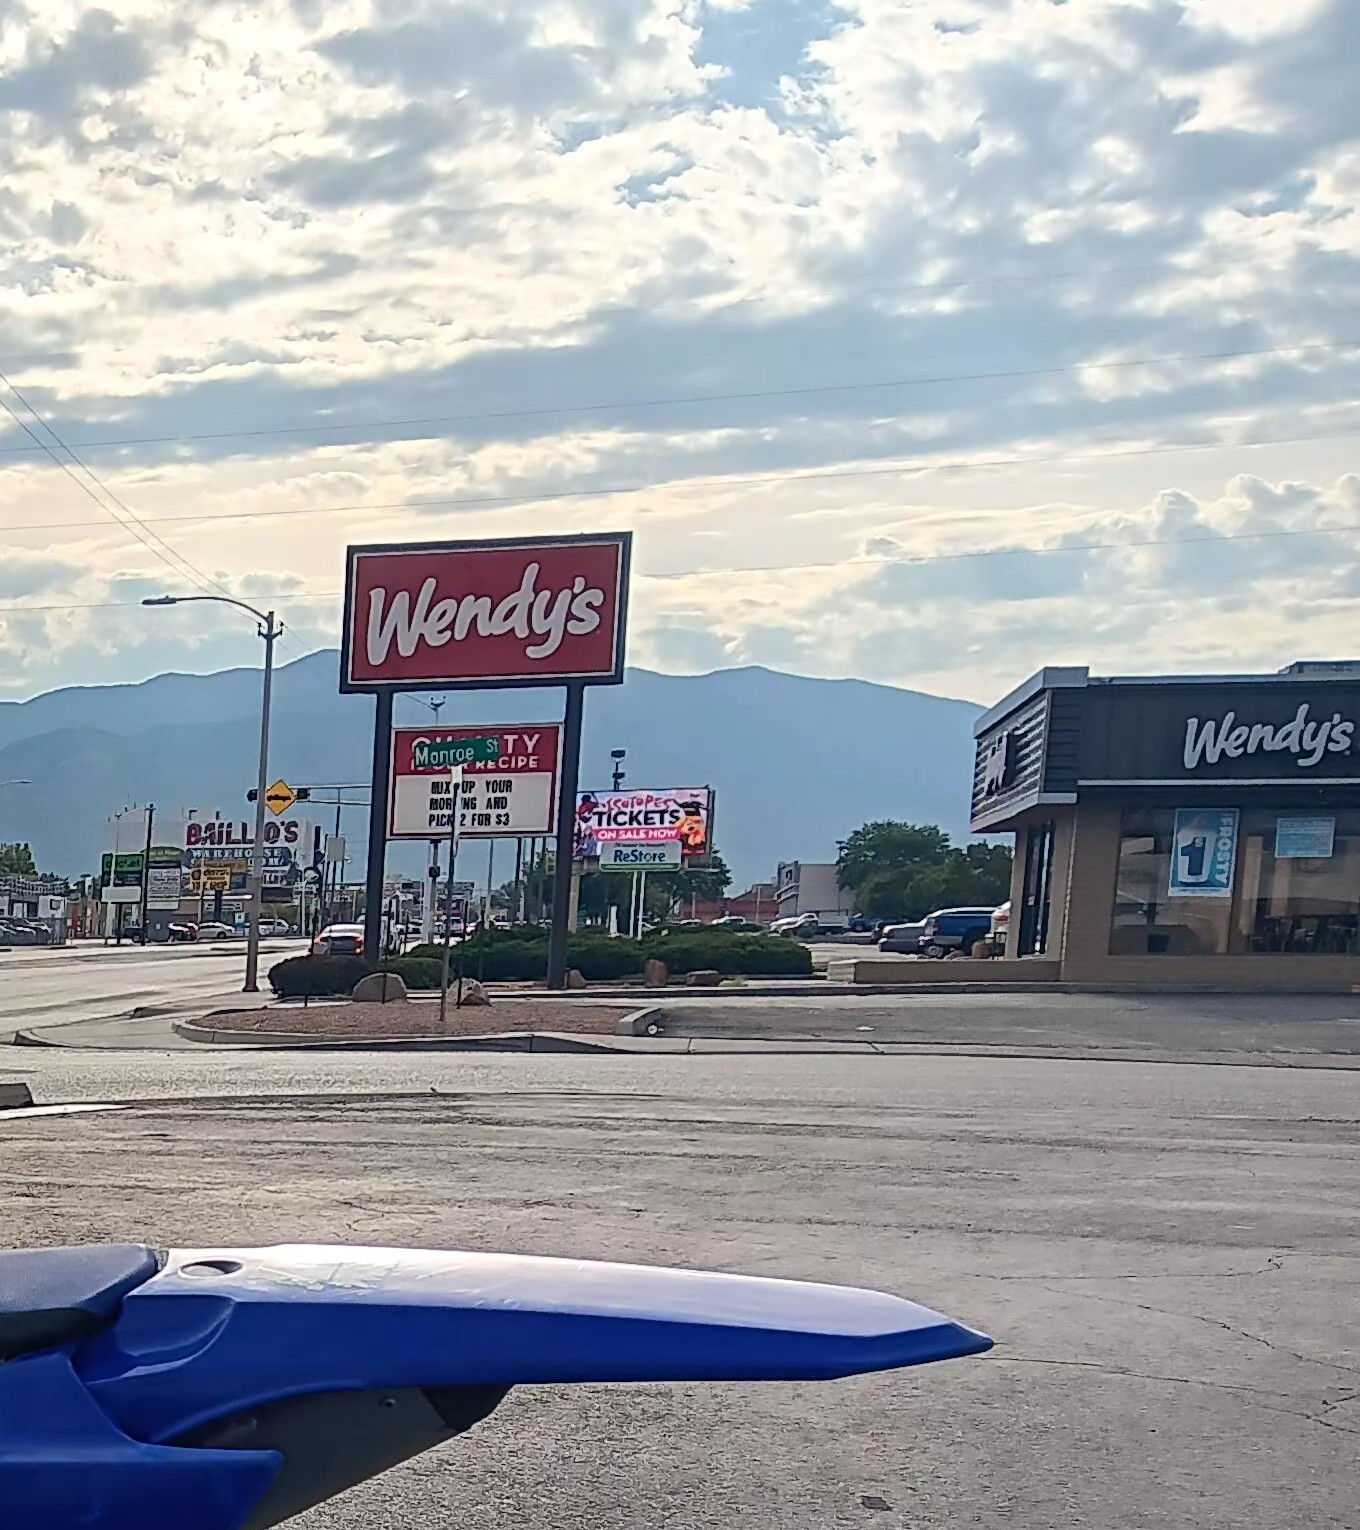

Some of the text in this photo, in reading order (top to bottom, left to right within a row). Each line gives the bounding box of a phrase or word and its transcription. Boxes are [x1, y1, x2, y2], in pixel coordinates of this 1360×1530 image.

[367, 562, 604, 666] Wendy's
[1183, 703, 1355, 769] Wendy's
[415, 746, 474, 766] Monroe
[486, 738, 498, 753] St
[431, 780, 512, 794] MIX UP YOUR
[486, 796, 507, 809] AND
[460, 813, 466, 826] 2
[471, 813, 491, 826] FOR
[593, 809, 680, 826] TICKETS
[186, 820, 299, 846] BAILLO'S
[597, 828, 678, 840] ON SALE NOW
[191, 848, 282, 859] WAREHOSE
[613, 849, 666, 862] ReStore
